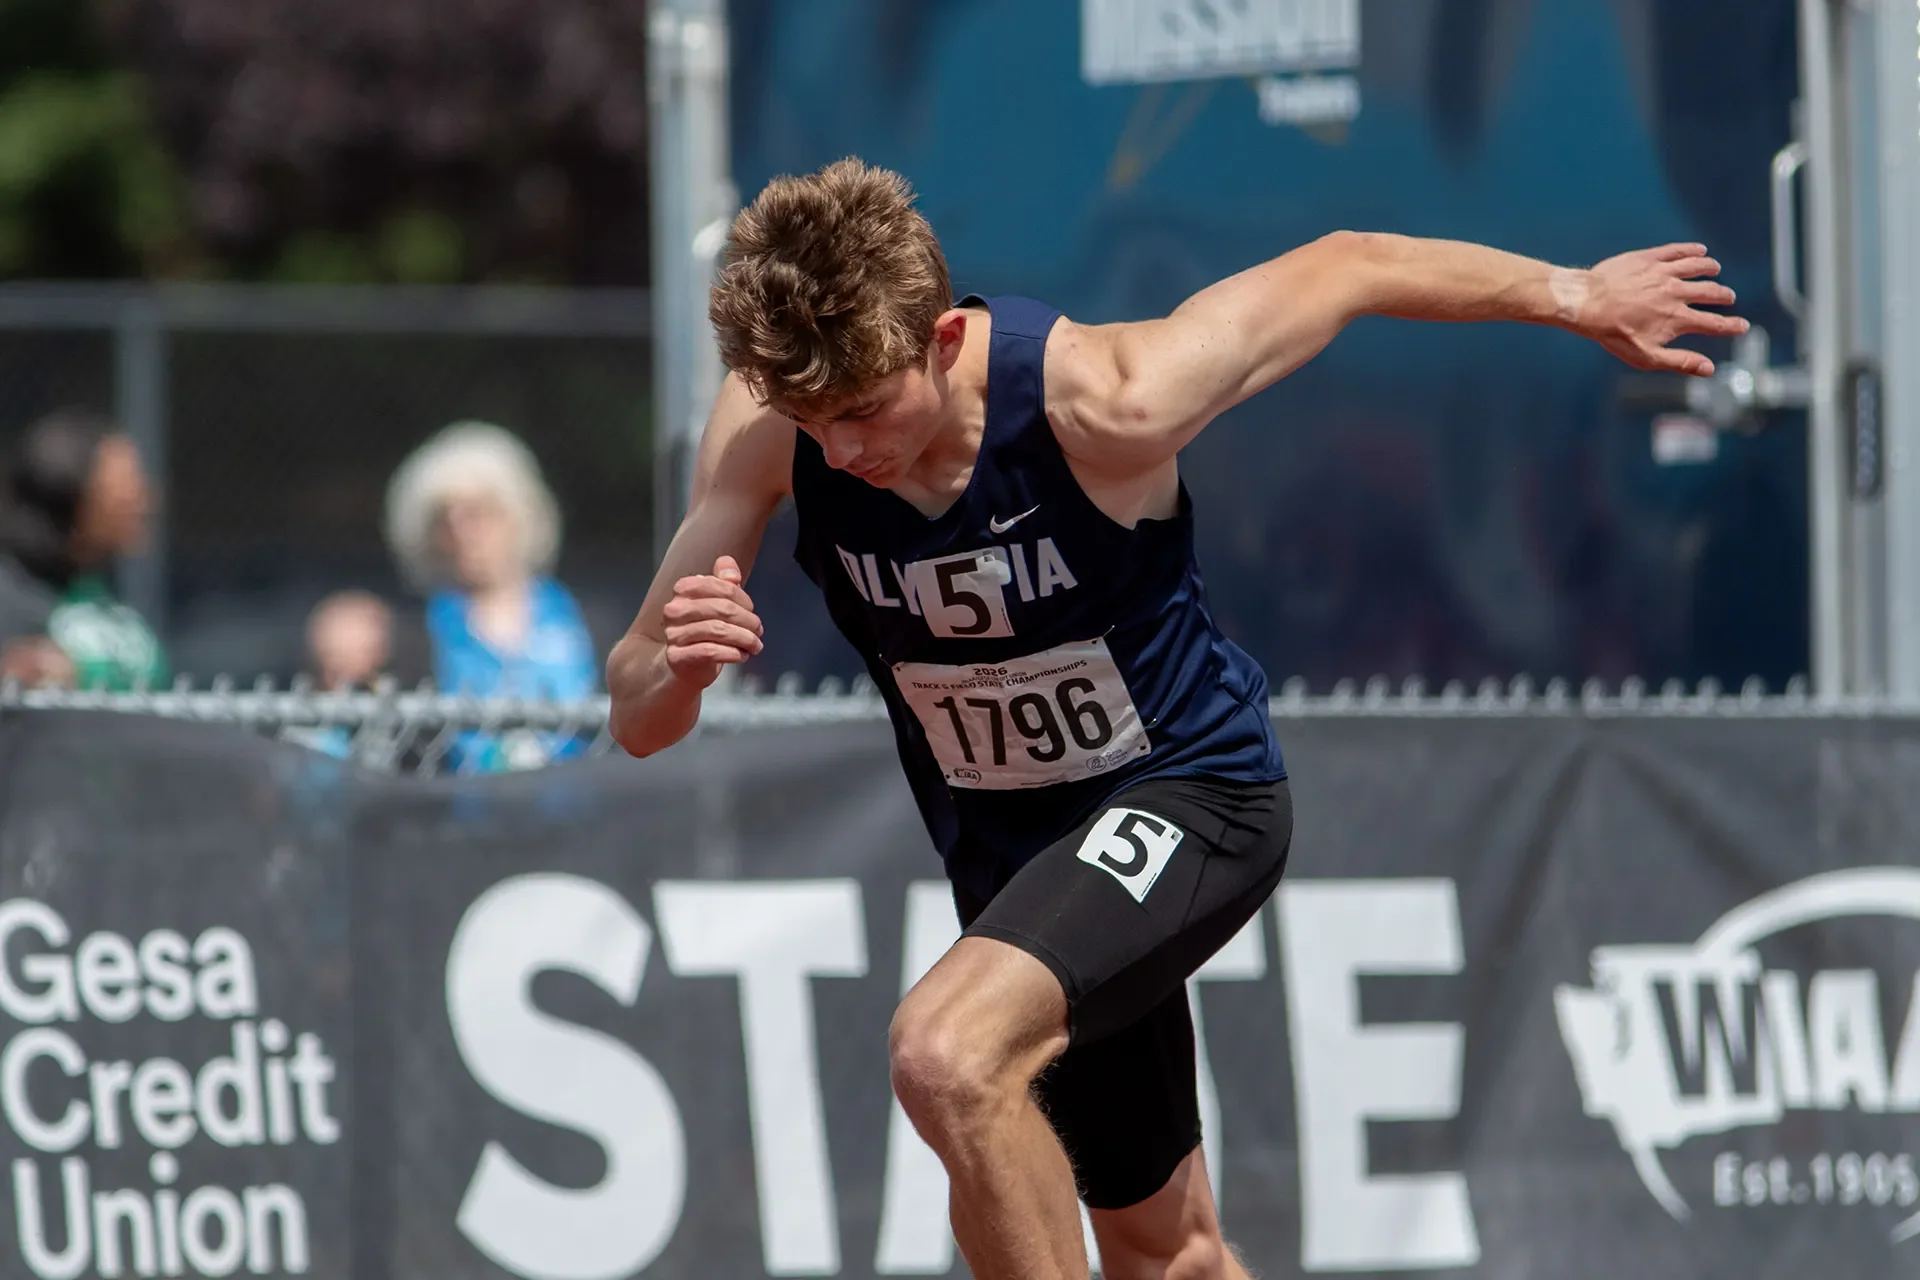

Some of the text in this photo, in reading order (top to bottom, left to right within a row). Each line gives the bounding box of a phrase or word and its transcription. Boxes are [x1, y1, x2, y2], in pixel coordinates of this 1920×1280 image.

[836, 537, 1078, 616] OLYIA
[934, 557, 992, 635] 5
[912, 681, 941, 690] TRACK
[950, 681, 977, 690] FIELD
[977, 679, 1004, 689] STATE
[1006, 659, 1088, 687] CHAMPIONSHIPS
[973, 666, 1008, 676] 2026
[933, 677, 1113, 766] 1796
[1097, 812, 1167, 877] 5
[0, 898, 259, 1025] Gesa
[1, 1017, 341, 1153] Credit
[12, 1150, 310, 1280] Union
